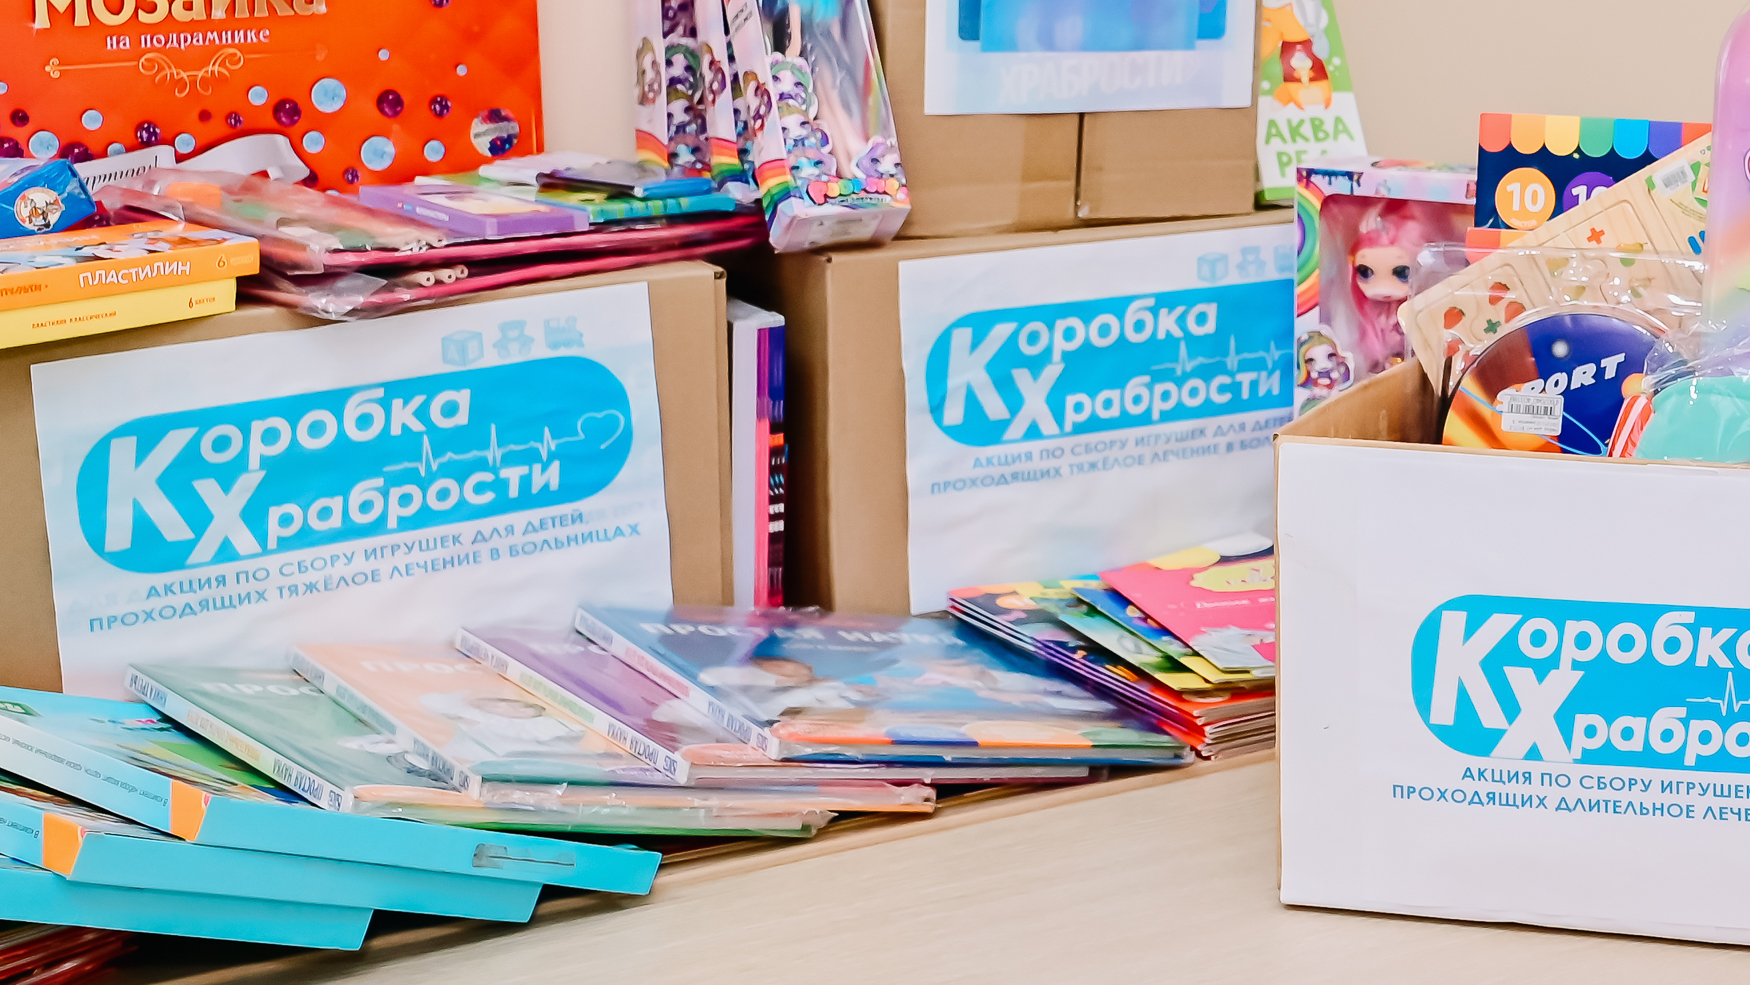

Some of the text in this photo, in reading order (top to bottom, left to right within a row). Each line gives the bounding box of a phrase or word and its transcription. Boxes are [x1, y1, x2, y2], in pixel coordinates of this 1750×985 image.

[106, 27, 271, 50] на подрамнике
[1264, 116, 1355, 145] АКВА
[1506, 183, 1545, 212] 10
[78, 260, 191, 288] ПЛАСТИЛИН
[216, 255, 227, 269] 6
[188, 297, 194, 309] 6
[942, 297, 1218, 426] Коробка
[1002, 363, 1281, 442] Храбрости
[973, 451, 1033, 469] АКЦИЯ
[1040, 446, 1065, 461] ПО
[1070, 437, 1128, 456] СБОРУ
[1212, 421, 1246, 437] ДЛЯ
[104, 387, 471, 553] Коробка
[931, 465, 1063, 495] ПРОХОДЯЩИХ
[1151, 443, 1220, 464] ЛЕЧЕНИЕ
[1226, 441, 1234, 453] В
[184, 460, 561, 566] Храбрости
[89, 522, 641, 633] ПРОХОДЯЩИХ ТЯЖЁЛОЕ ЛЕЧЕНИЕ В БОЛЬНИЦАХ
[145, 575, 227, 600] АКЦИЯ
[235, 567, 270, 586] ПО
[279, 551, 355, 578] СБОРУ
[364, 532, 462, 561] ИГРУШЕК
[471, 524, 515, 546] ДЛЯ
[629, 736, 660, 765] ПРОСТАЯ
[293, 771, 324, 802] ПРОСТАЯ
[1461, 767, 1532, 785] АКЦИЯ
[1541, 773, 1571, 788] ПО
[1579, 775, 1653, 792] СБОРУ
[1392, 784, 1548, 809] ПРОХОДЯЩИХ
[1555, 796, 1695, 819] ДЛИТЕЛЬНОЕ
